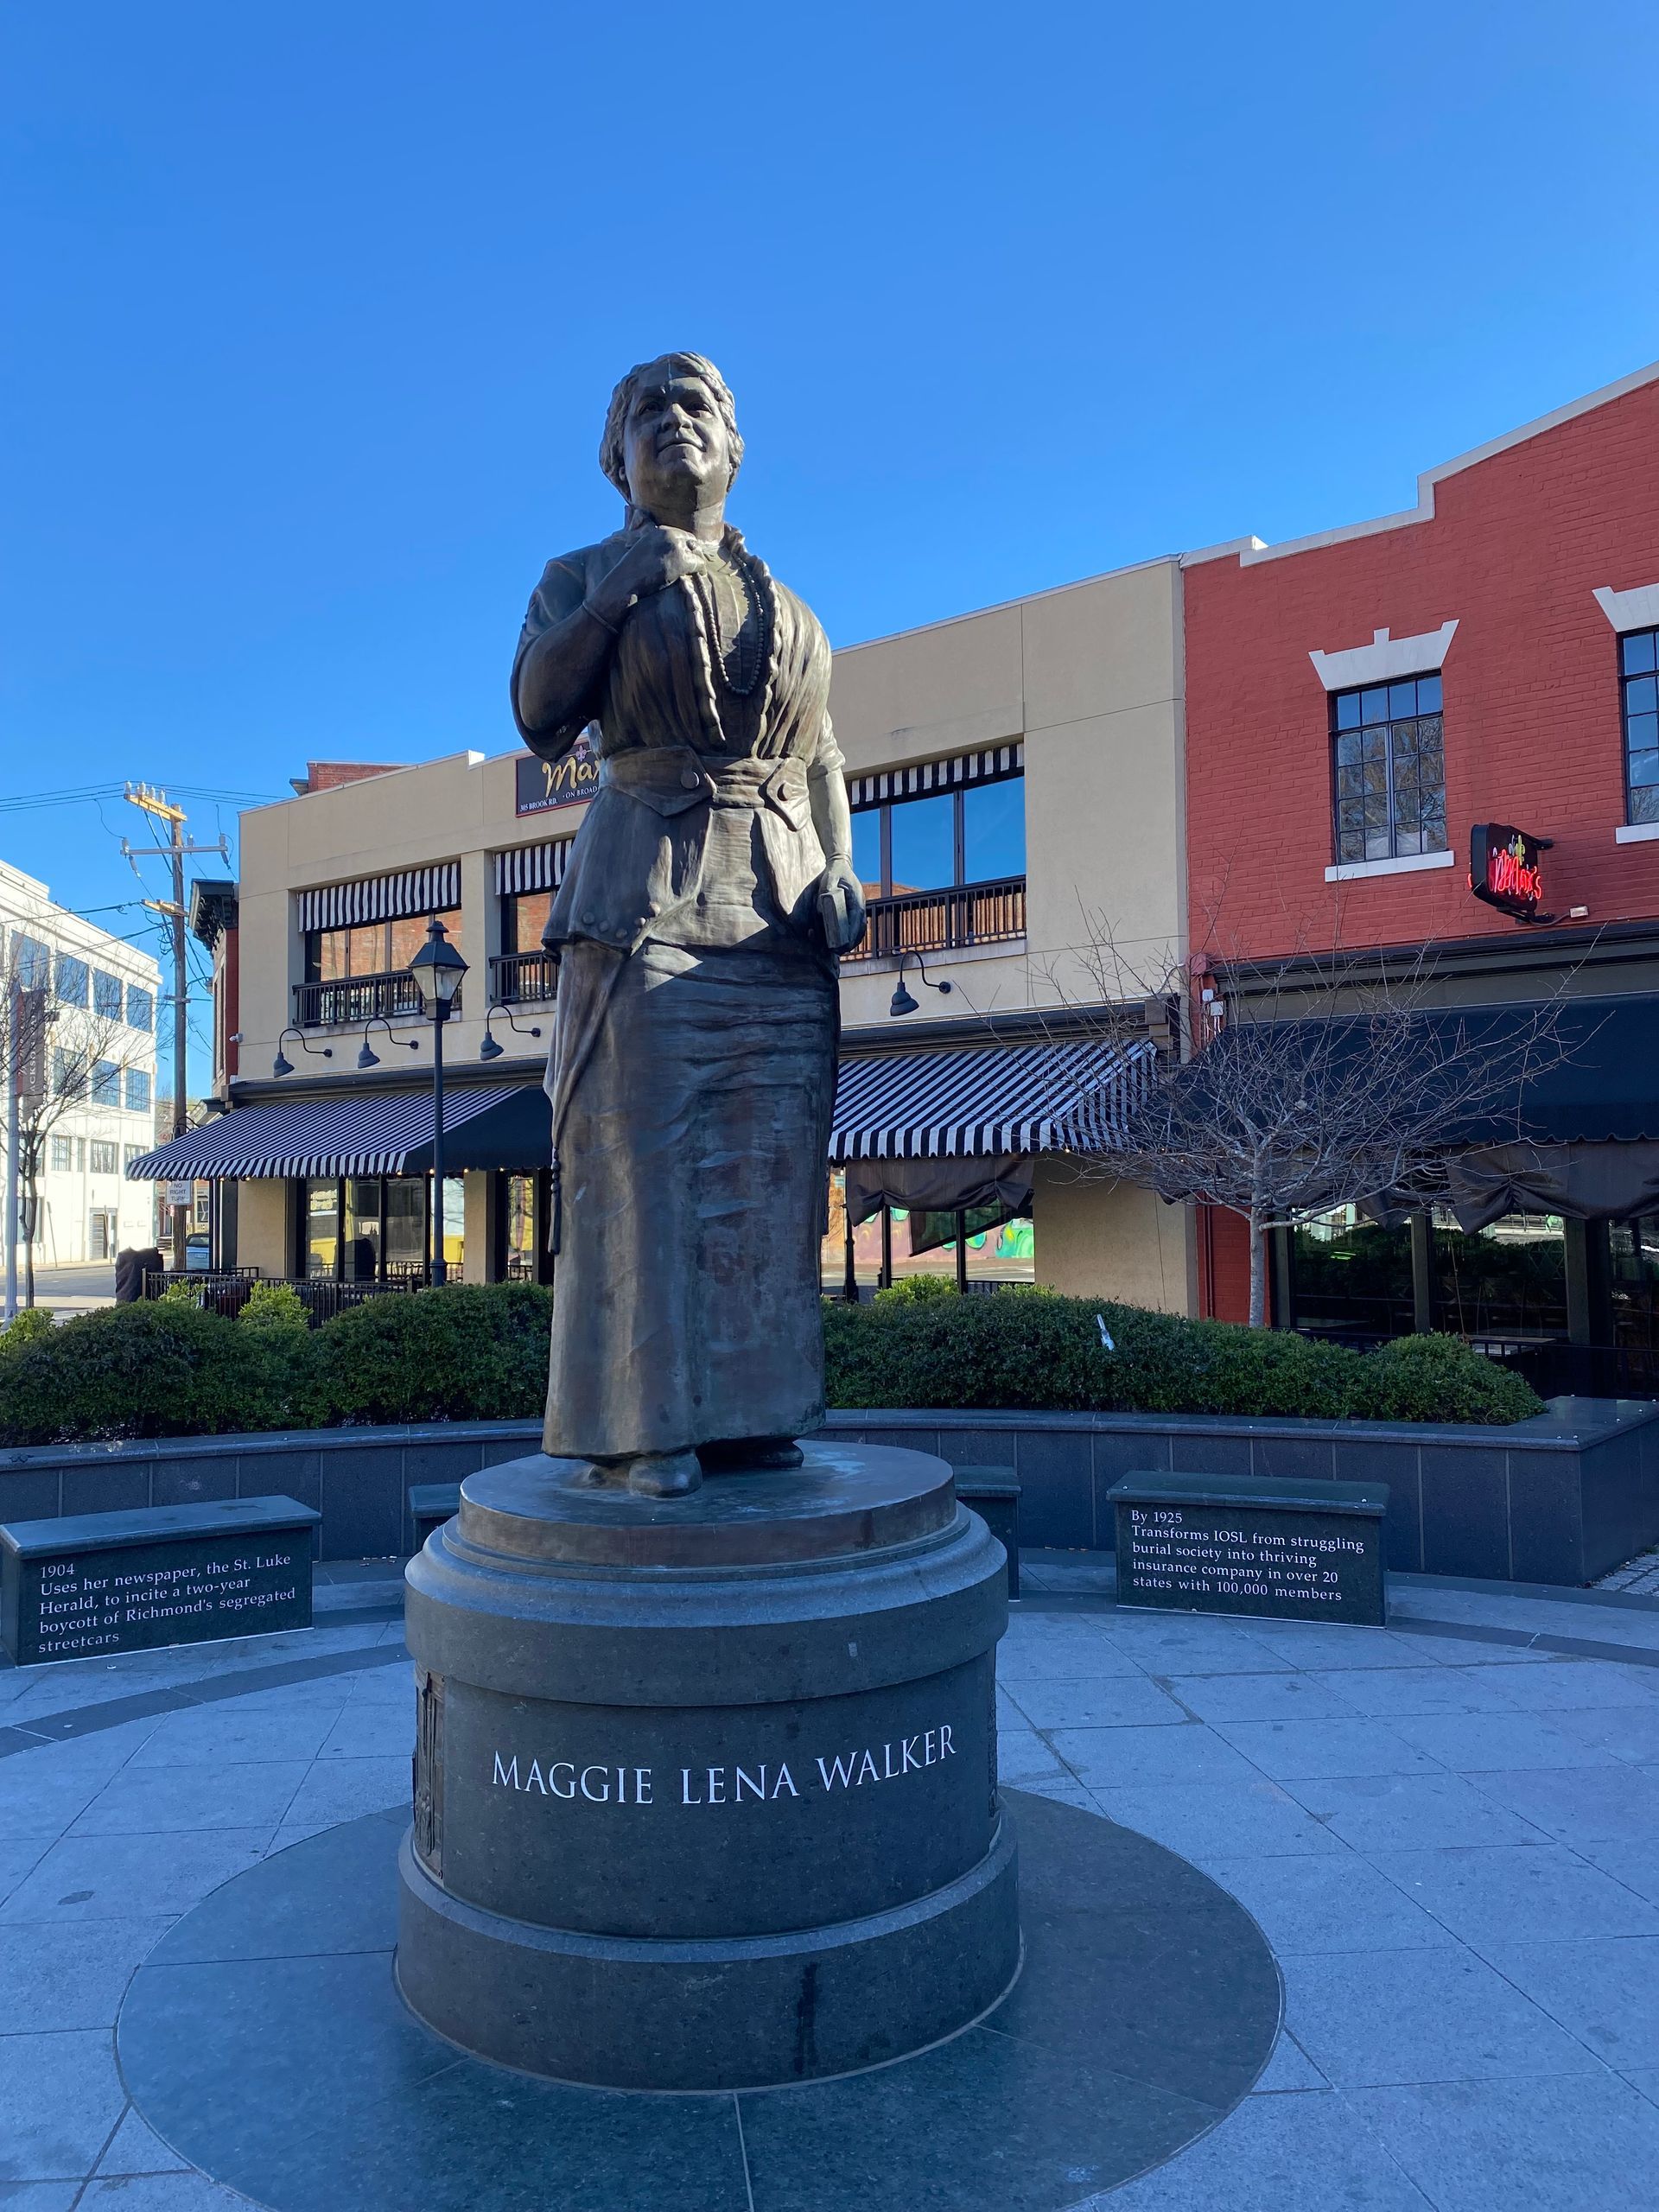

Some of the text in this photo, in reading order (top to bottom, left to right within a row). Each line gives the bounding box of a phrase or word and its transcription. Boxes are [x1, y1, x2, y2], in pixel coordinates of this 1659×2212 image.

[576, 785, 598, 797] BROAD
[529, 799, 548, 810] BROOK
[1131, 1510, 1183, 1525] By 1925
[1131, 1525, 1364, 1555] Transforms IOSL from struggling
[1132, 1541, 1317, 1568] burial society into thriving
[40, 1563, 75, 1580] 1904
[41, 1554, 291, 1596] Uses her newspaper, the St. Luke
[1133, 1559, 1338, 1584] insurance company in over 20
[40, 1577, 251, 1615] Herald, to incite a two-year
[1133, 1576, 1342, 1601] states with 100,000 members
[40, 1586, 296, 1636] boycott of Richmond's segregated
[38, 1633, 119, 1653] streetcars
[492, 1725, 957, 1804] MAGGIE LENA WALKER
